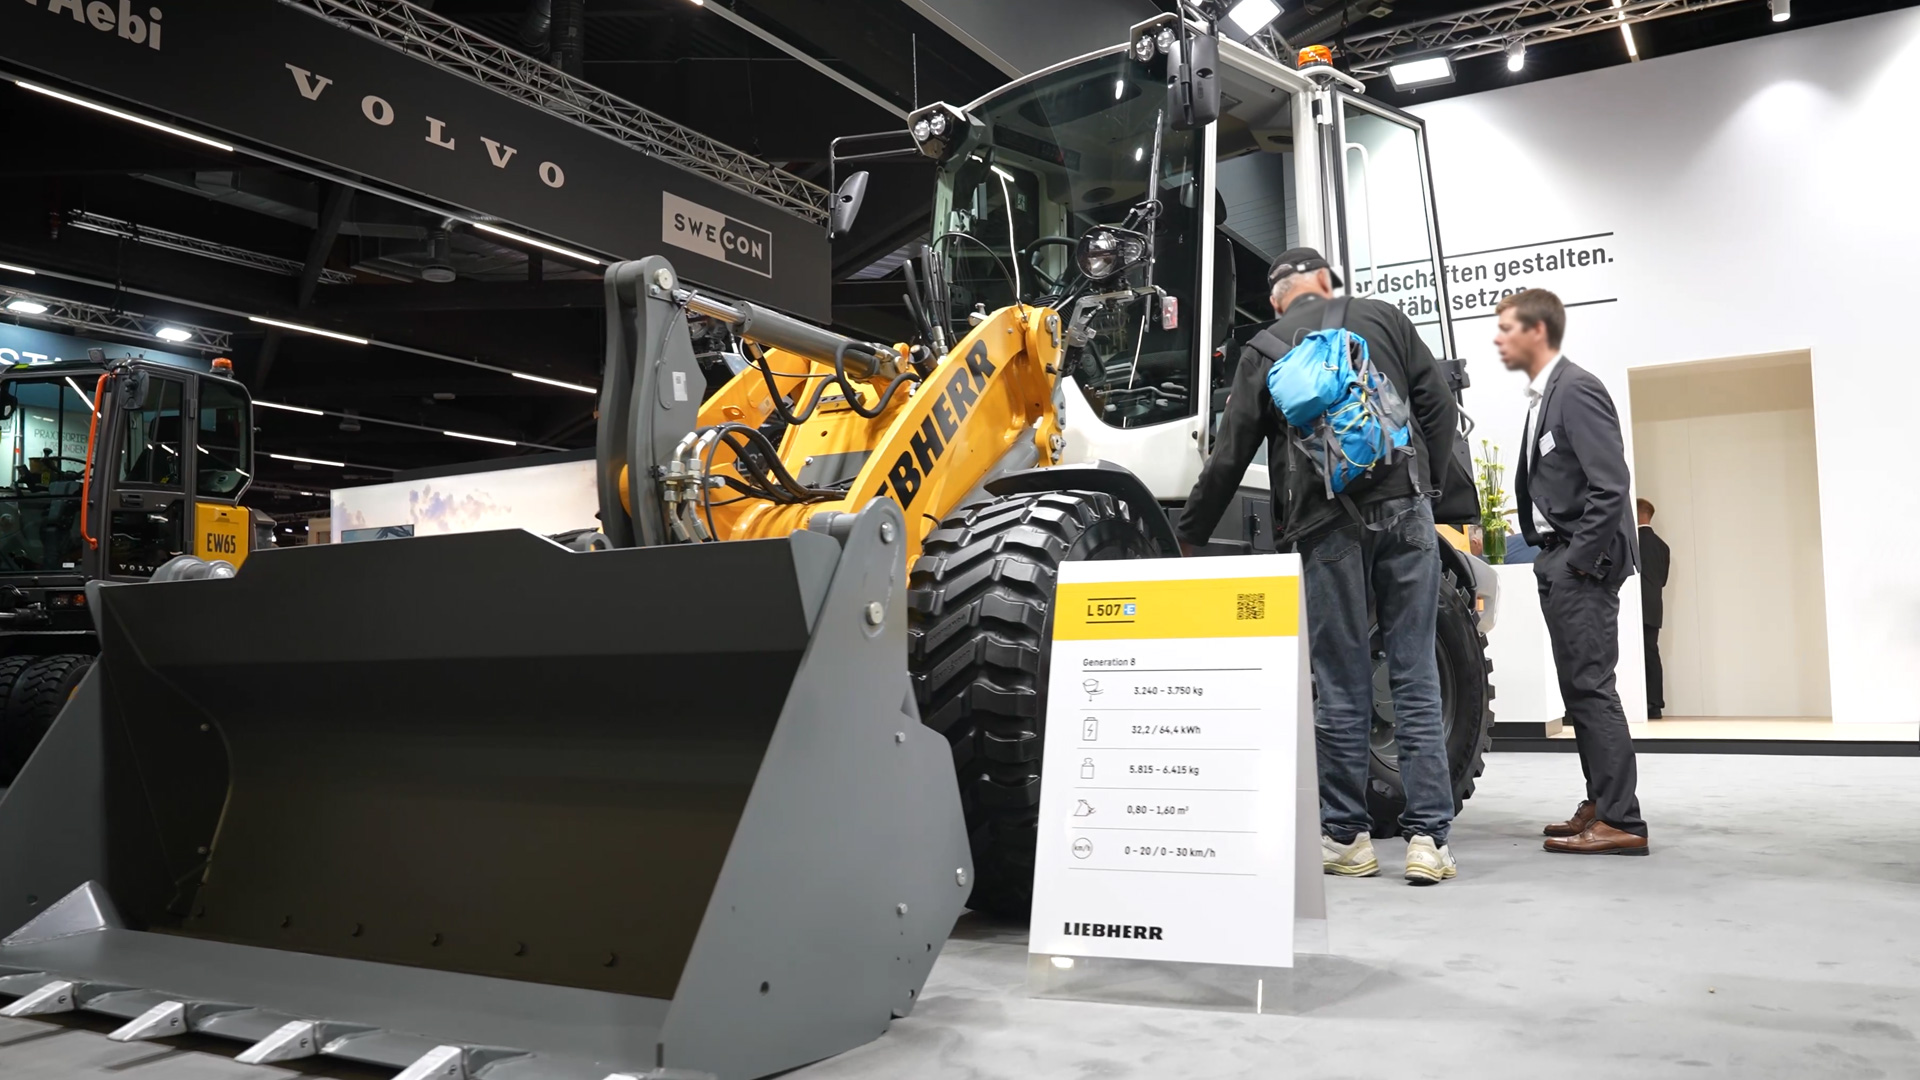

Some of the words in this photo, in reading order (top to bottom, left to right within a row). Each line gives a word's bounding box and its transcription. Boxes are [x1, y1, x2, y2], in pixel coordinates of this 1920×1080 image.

[285, 63, 565, 188] VOLVO
[674, 213, 762, 260] SWECON
[1494, 247, 1614, 282] gestalten.
[207, 533, 236, 554] EW65
[1087, 605, 1094, 616] L
[1097, 604, 1121, 616] 507
[1083, 658, 1128, 666] Generation
[1130, 658, 1136, 666] 8
[1134, 686, 1158, 695] 3.240
[1167, 686, 1191, 695] 3.750
[1193, 687, 1203, 697] kg
[1131, 725, 1150, 735] 32,2
[1159, 725, 1179, 735] 64,4
[1180, 725, 1202, 734] kWh
[1129, 765, 1154, 774] 5.815
[1162, 765, 1187, 775] 6.415
[1189, 766, 1200, 776] kg
[1127, 805, 1147, 815] 0,80
[1156, 805, 1175, 815] 1,60
[1124, 846, 1131, 855] 0
[1140, 846, 1151, 855] 20
[1160, 847, 1167, 856] 0
[1176, 848, 1188, 857] 30
[1189, 848, 1216, 858] km/h
[1063, 922, 1163, 940] LIEBHERR
